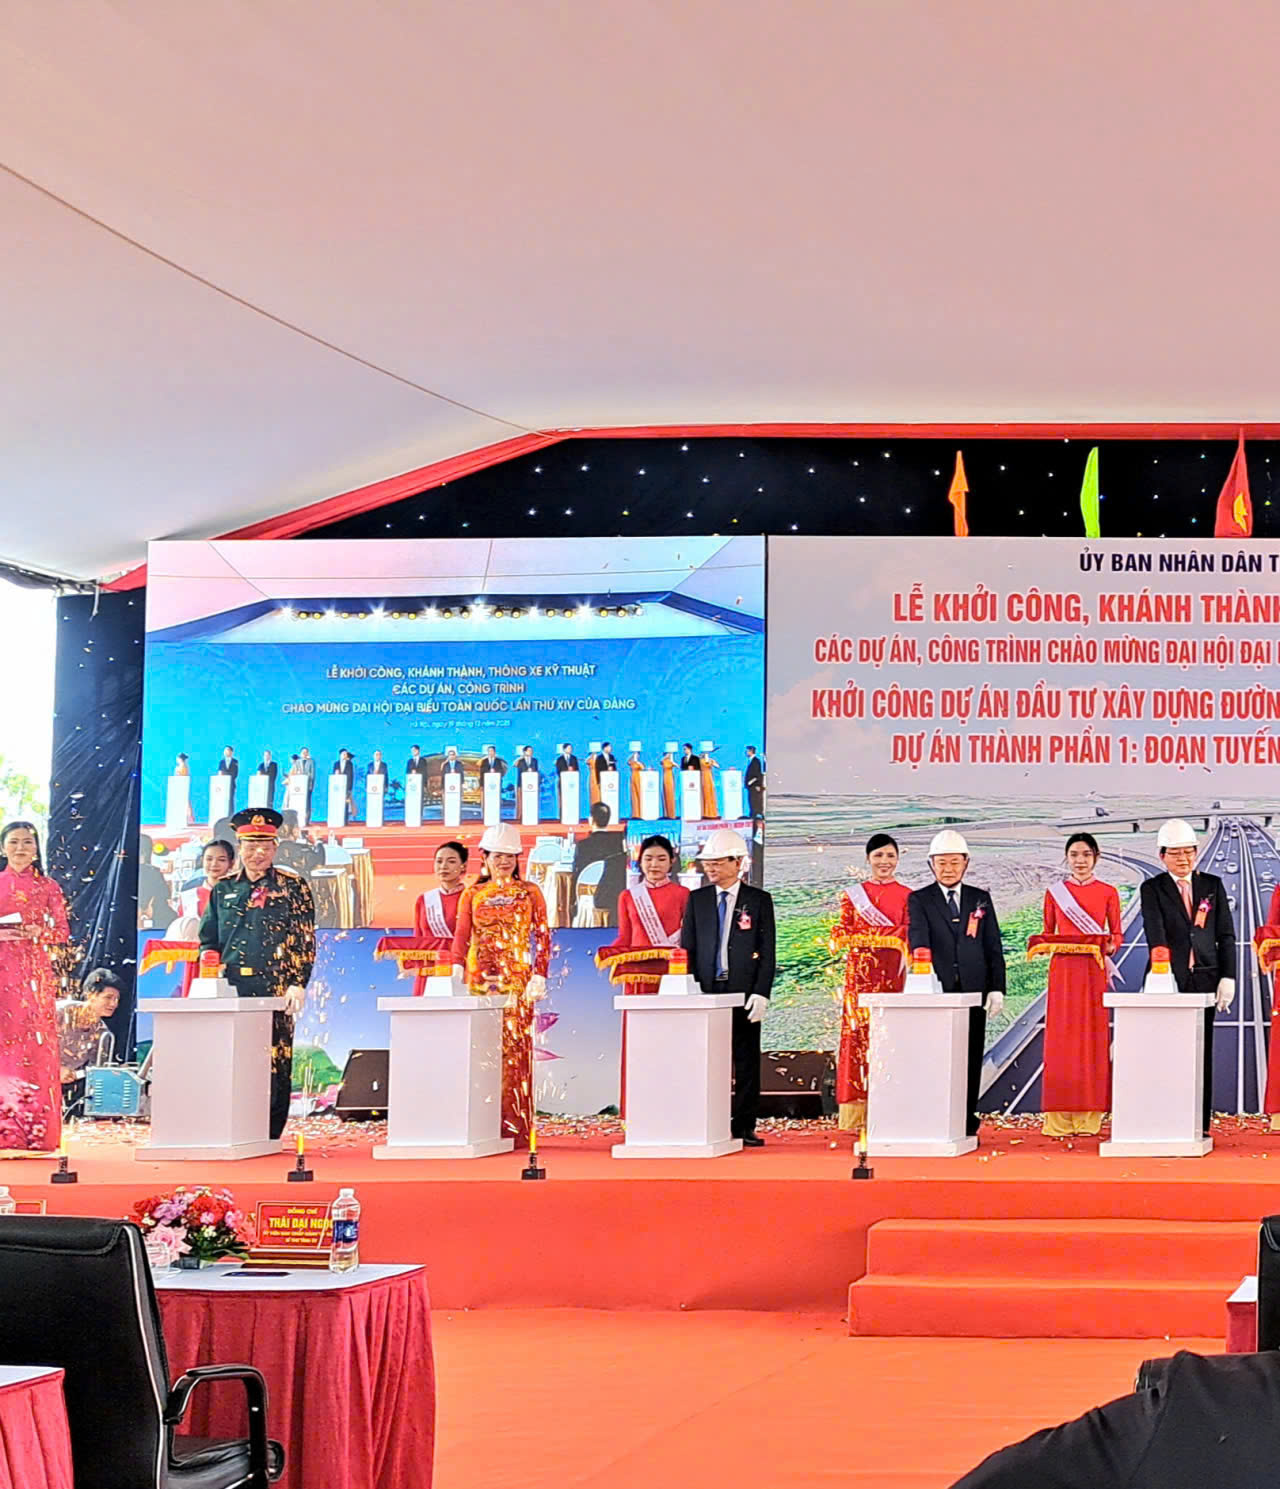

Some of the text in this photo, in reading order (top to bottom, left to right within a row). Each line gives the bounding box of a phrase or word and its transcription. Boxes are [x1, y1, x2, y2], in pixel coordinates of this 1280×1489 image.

[1079, 547, 1105, 572] ỦY
[1111, 553, 1152, 572] BAN
[1159, 550, 1215, 572] NHÂN
[1221, 550, 1262, 573] DÂN
[893, 583, 925, 622] LỄ
[933, 584, 998, 623] KHỞI
[1007, 587, 1089, 625] CÔNG,
[1098, 590, 1192, 623] KHÁNH
[339, 665, 367, 679] KHỞI
[367, 665, 406, 680] CÔNG,
[407, 664, 445, 678] KHÁNH
[446, 664, 486, 681] THÀNH,
[488, 664, 528, 677] THÔNG
[529, 665, 543, 677] XE
[544, 663, 560, 676] KỸ
[561, 663, 596, 678] THUẬT
[815, 633, 853, 664] CÁC
[858, 637, 887, 669] DỰ
[889, 633, 921, 668] ÁN,
[928, 634, 980, 664] CÔNG
[986, 633, 1041, 664] TRÌNH
[1047, 633, 1098, 664] CHÀO
[1103, 633, 1161, 665] MỪNG
[1165, 639, 1198, 671] ĐẠI
[1203, 635, 1235, 671] HỘI
[1239, 639, 1272, 671] ĐẠI
[812, 680, 865, 719] KHỞI
[872, 684, 934, 719] CÔNG
[941, 687, 974, 724] DỰ
[978, 683, 1009, 719] ÁN
[1015, 682, 1062, 719] ĐẦU
[1067, 688, 1098, 720] TƯ
[1103, 685, 1145, 719] XÂY
[1153, 685, 1214, 726] DỰNG
[892, 734, 924, 769] DỰ
[929, 729, 961, 765] ÁN
[967, 730, 1042, 765] THÀNH
[1048, 726, 1111, 765] PHẦN
[1118, 736, 1138, 765] 1:
[1144, 735, 1206, 771] ĐOẠN
